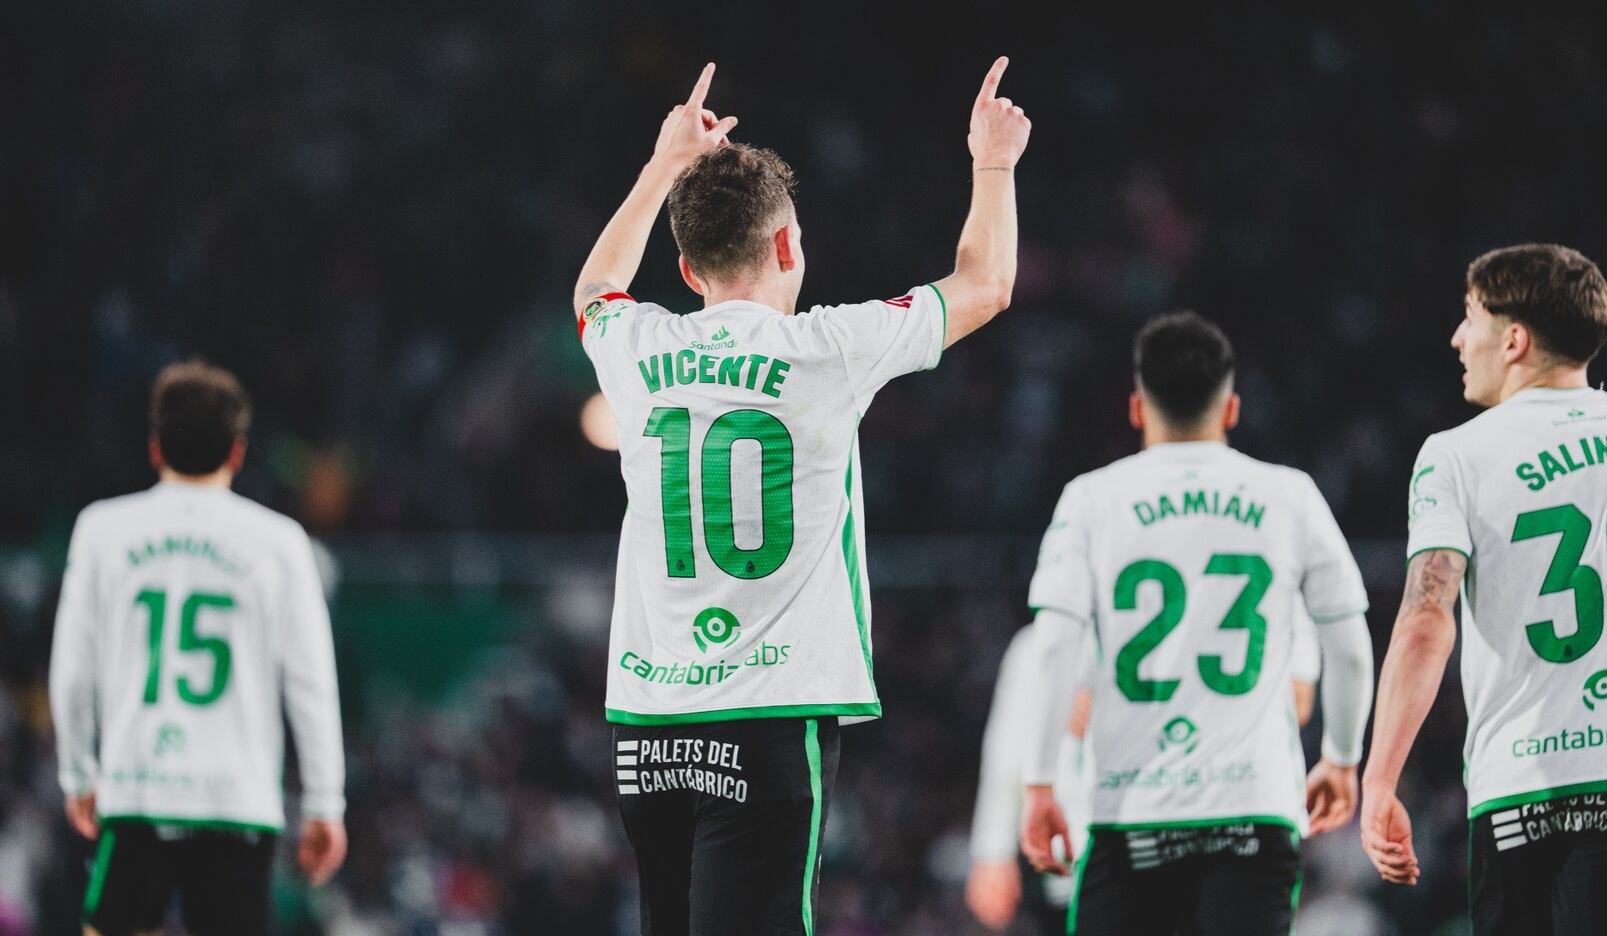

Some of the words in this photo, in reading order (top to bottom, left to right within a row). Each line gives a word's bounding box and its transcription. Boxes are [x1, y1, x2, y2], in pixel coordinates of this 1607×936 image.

[689, 338, 737, 351] Santand
[638, 349, 791, 399] VICENTE
[643, 407, 794, 580] 10
[1133, 484, 1266, 529] DAMIÁN
[1511, 503, 1604, 664] 3
[135, 588, 235, 706] 15
[1113, 553, 1273, 703] 23
[744, 640, 791, 667] abs
[640, 738, 704, 764] PALETS
[707, 740, 743, 771] DEL
[1512, 724, 1607, 757] cantab
[640, 765, 748, 803] CANTÁBRICO
